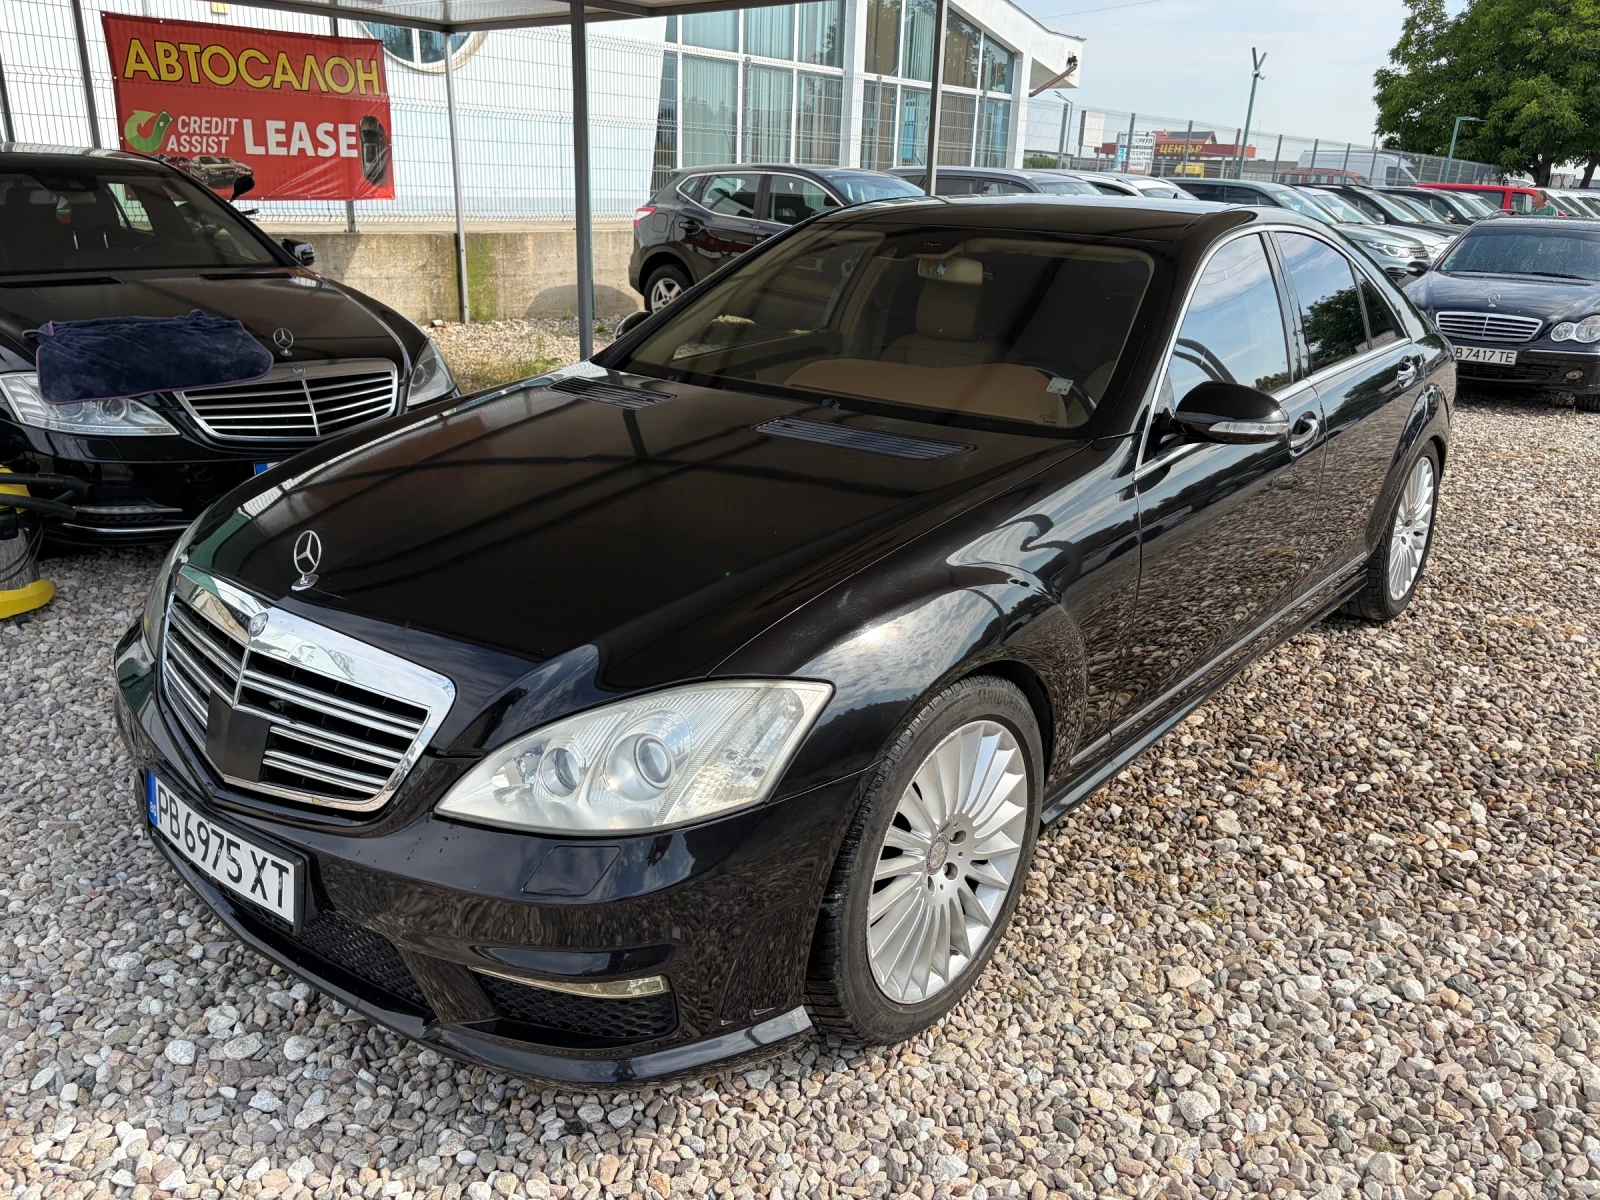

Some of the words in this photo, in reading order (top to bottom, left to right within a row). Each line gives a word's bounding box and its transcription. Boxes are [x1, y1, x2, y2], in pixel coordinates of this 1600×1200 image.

[123, 38, 381, 96] АВТОСАЛОН
[177, 115, 239, 136] CREDIT
[242, 118, 359, 158] LEASE
[166, 134, 230, 154] ASSIST
[1465, 347, 1496, 361] 7417
[1498, 350, 1515, 364] TE
[184, 811, 243, 884] 6975
